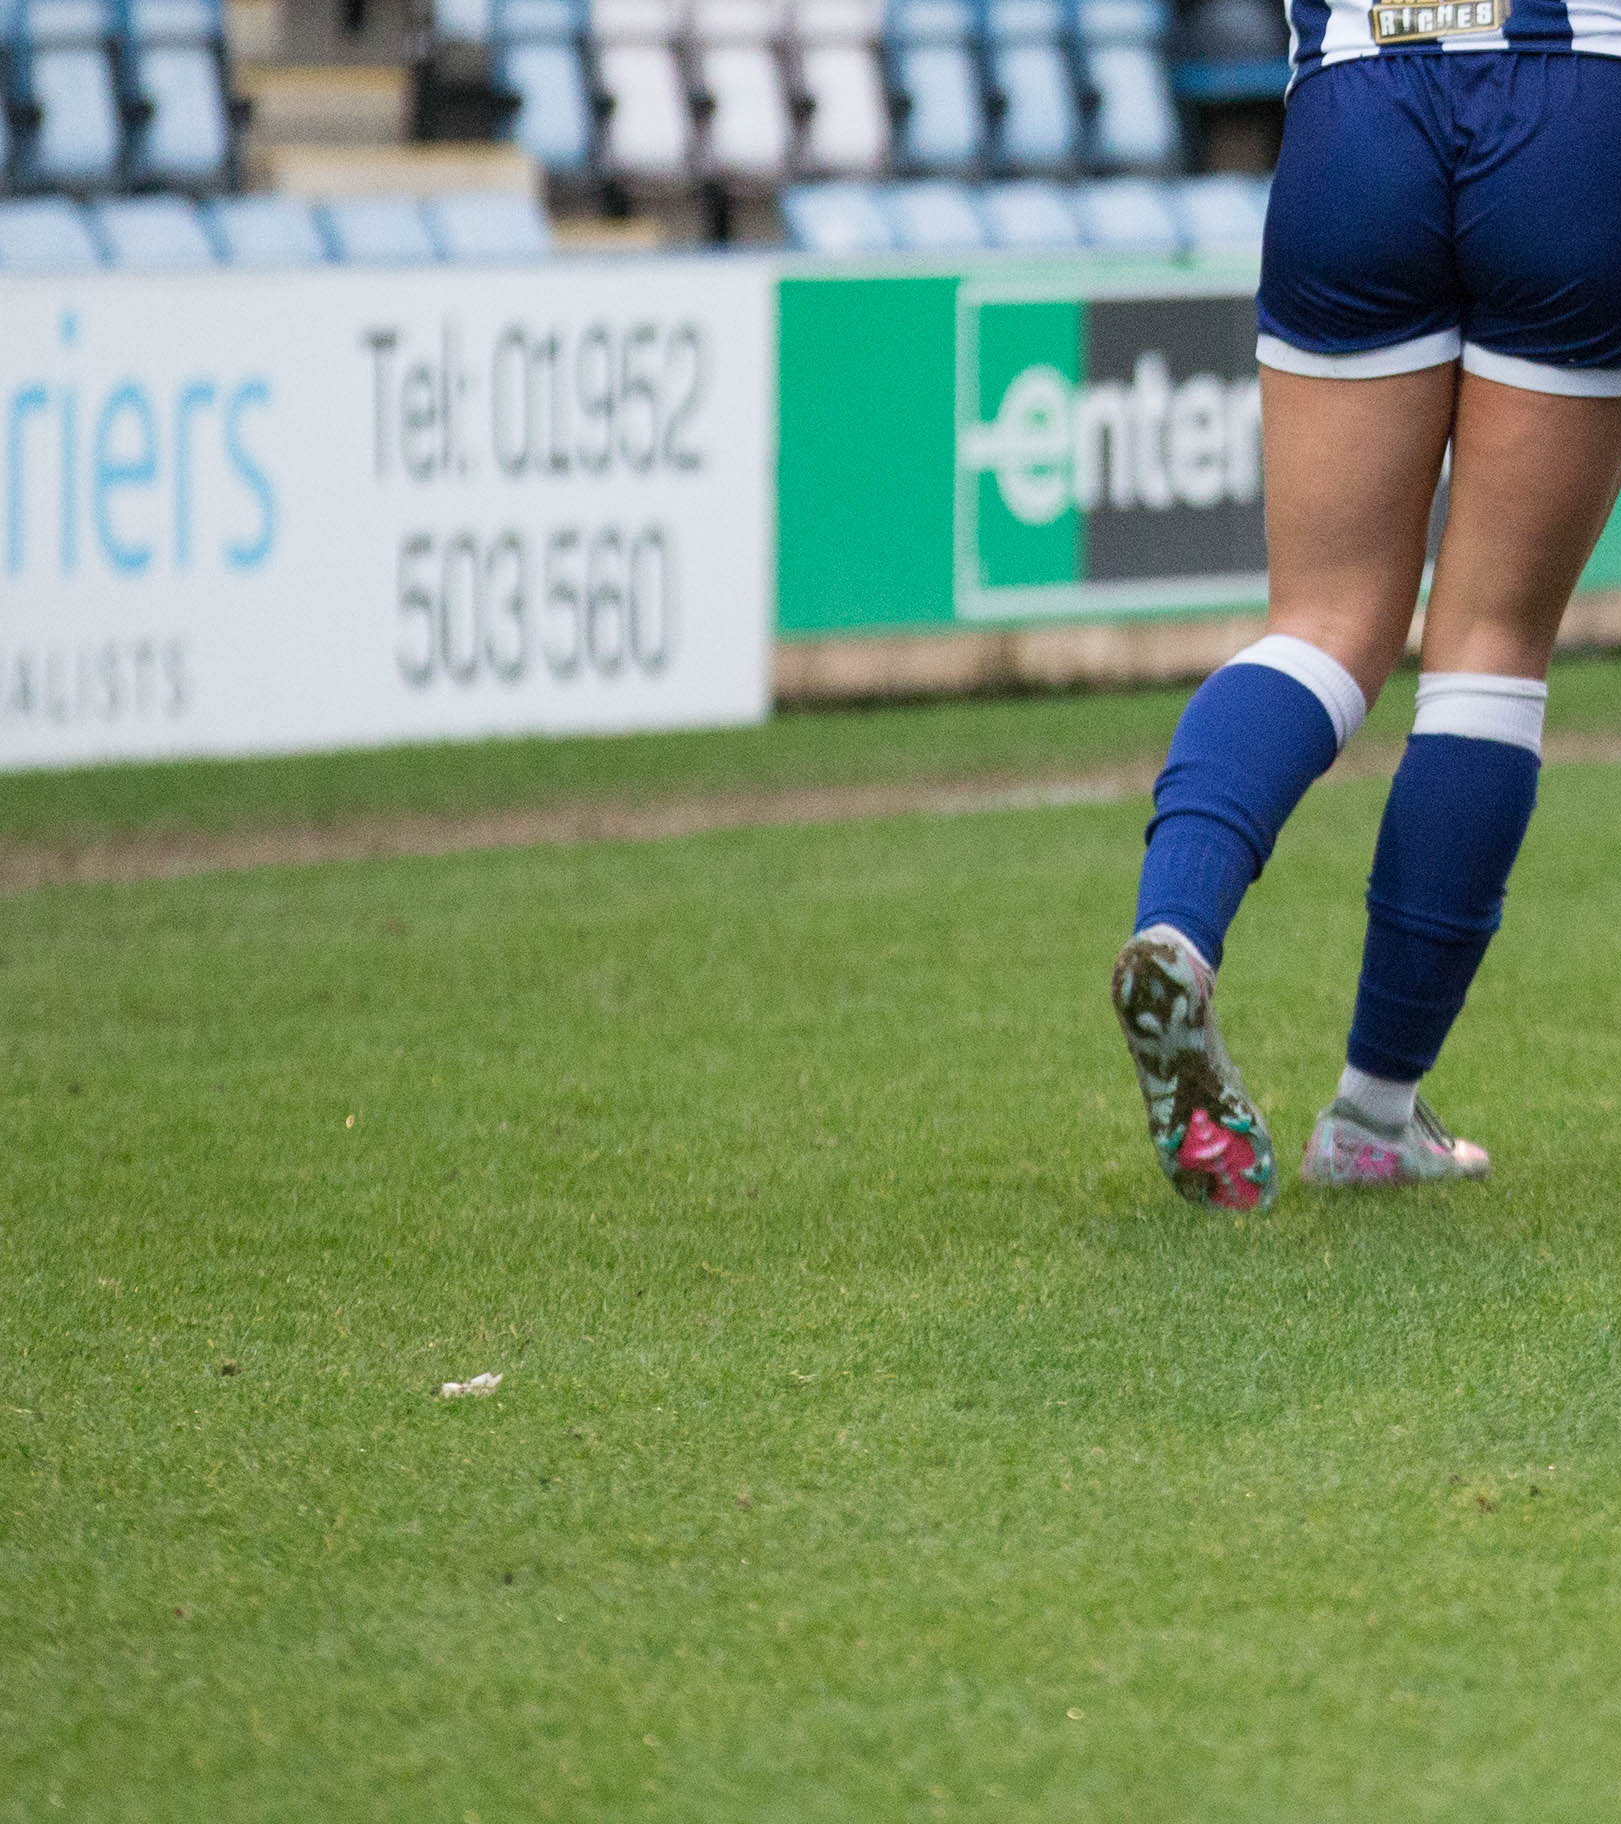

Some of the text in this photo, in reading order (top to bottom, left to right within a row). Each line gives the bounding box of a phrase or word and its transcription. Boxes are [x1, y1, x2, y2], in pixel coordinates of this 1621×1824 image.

[1379, 0, 1493, 37] RICHES
[362, 316, 712, 480] Tel: 01952
[398, 521, 672, 688] 503 560
